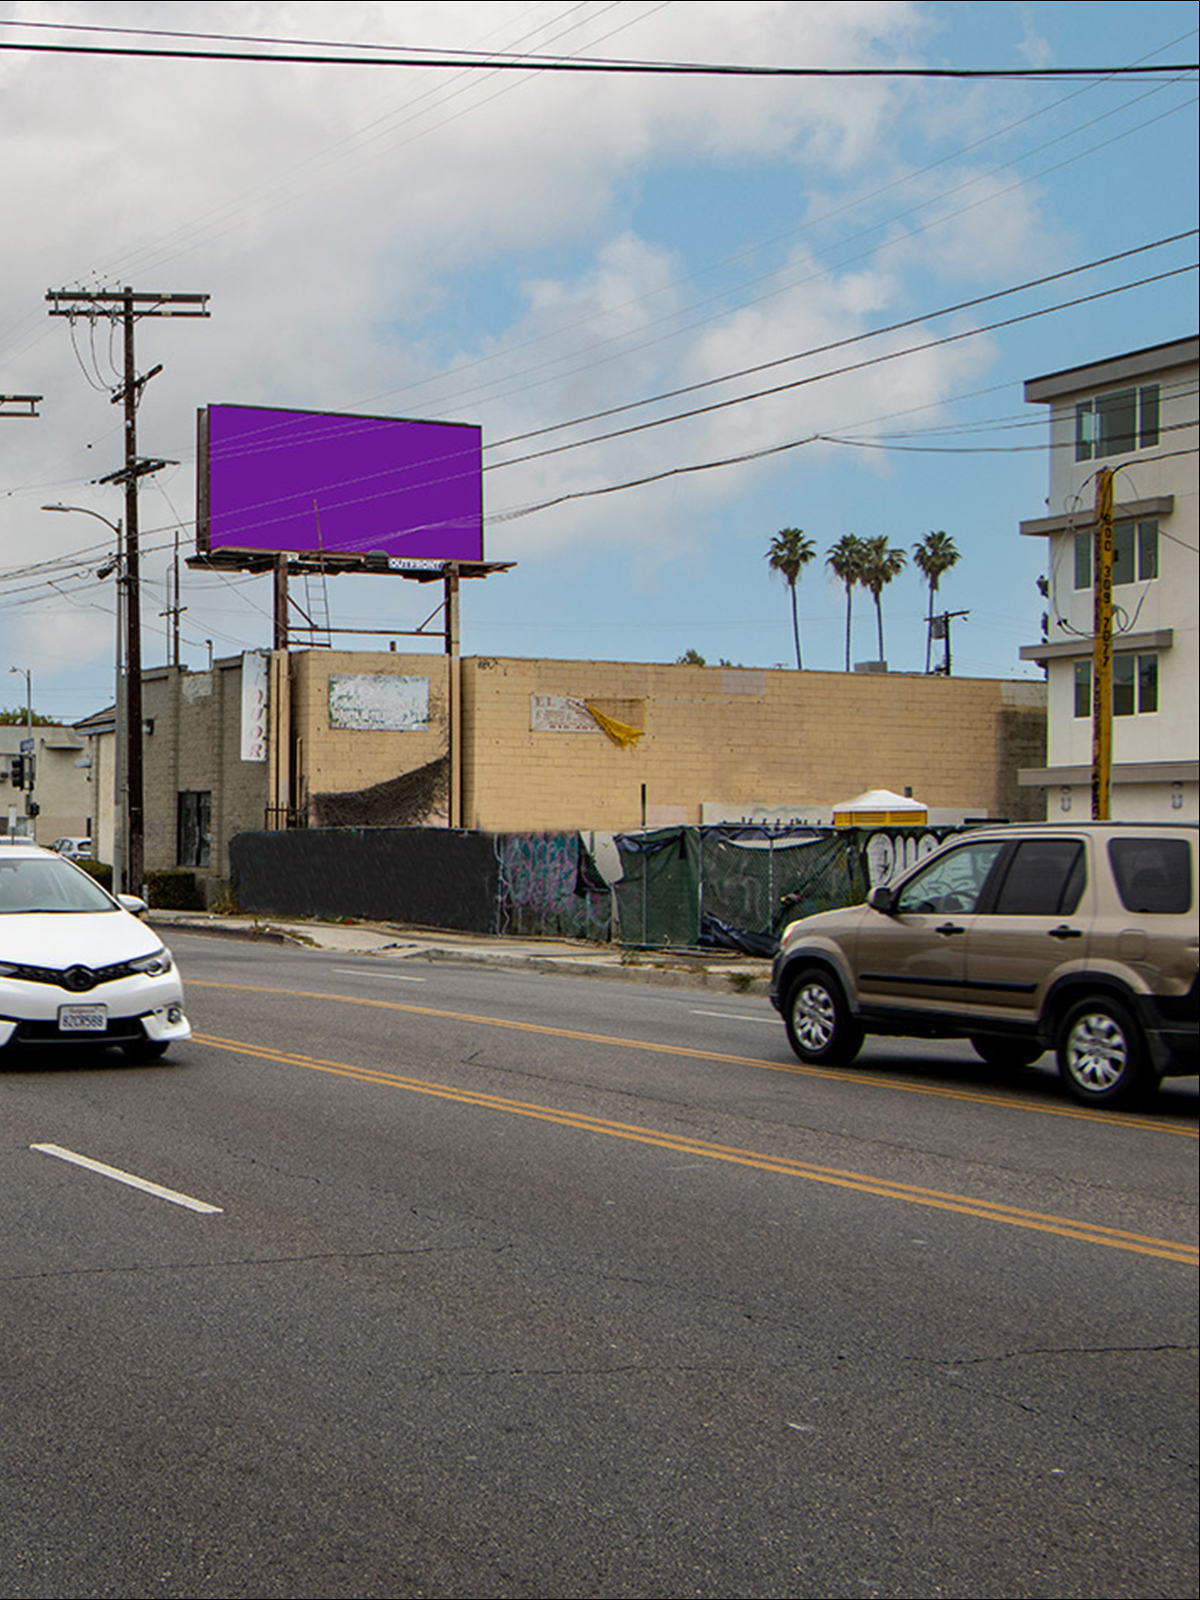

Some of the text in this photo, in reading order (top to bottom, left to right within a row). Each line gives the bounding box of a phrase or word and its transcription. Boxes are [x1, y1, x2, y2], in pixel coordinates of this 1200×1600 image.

[389, 557, 445, 571] OUTFRONT
[1103, 565, 1111, 603] 309
[1102, 617, 1110, 667] 7077
